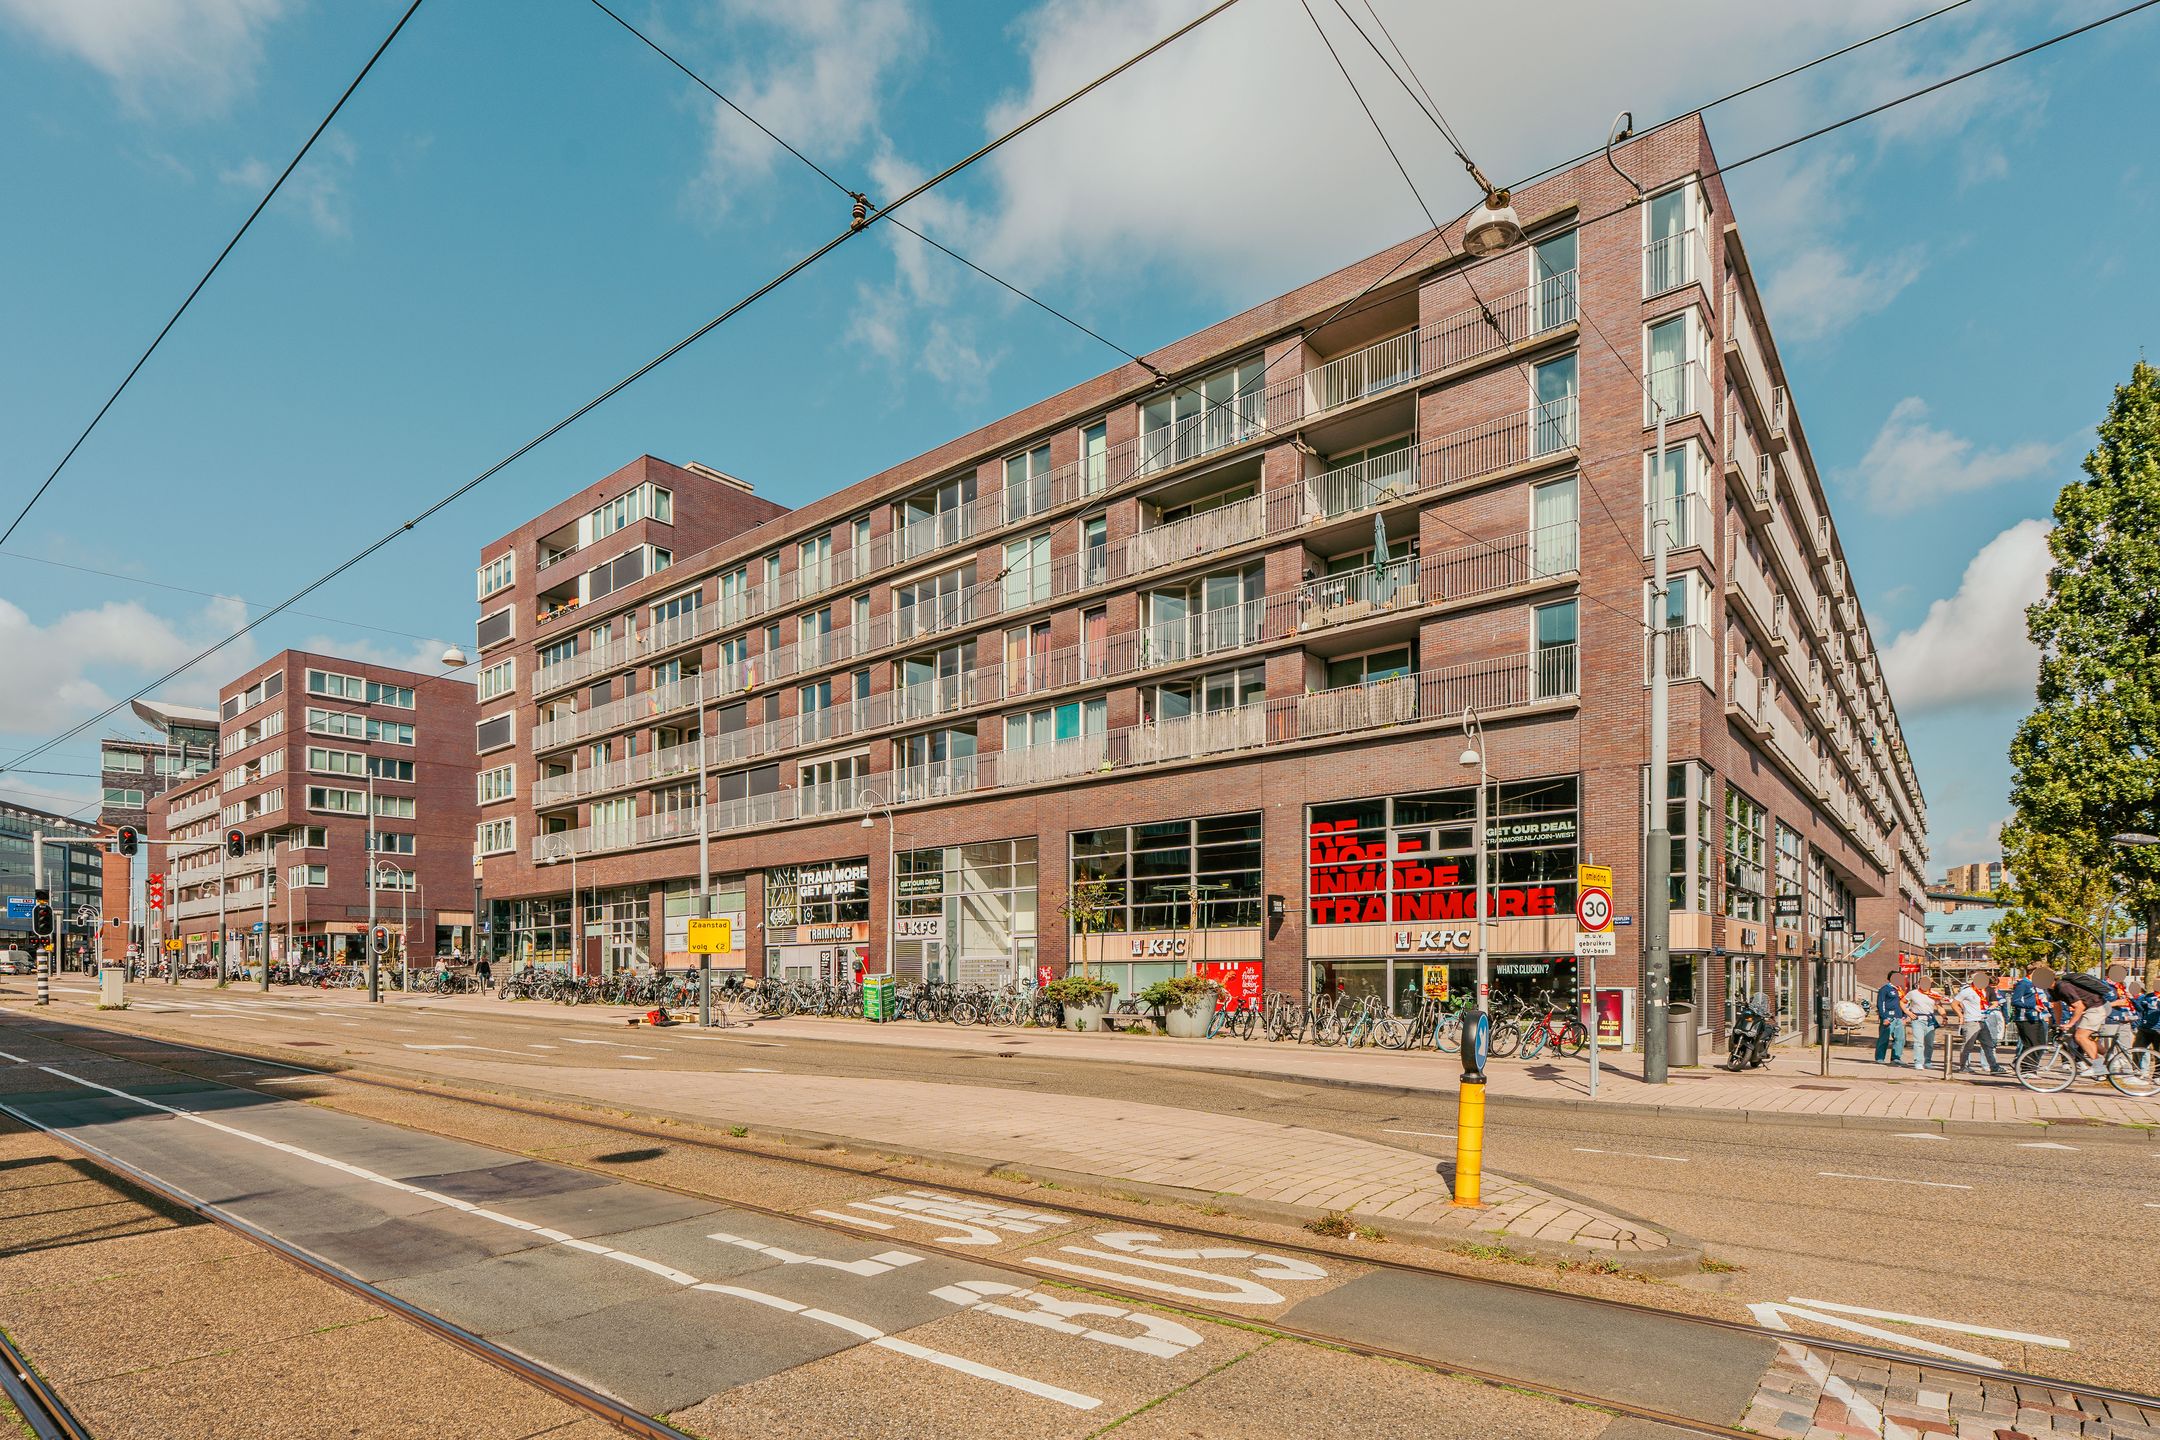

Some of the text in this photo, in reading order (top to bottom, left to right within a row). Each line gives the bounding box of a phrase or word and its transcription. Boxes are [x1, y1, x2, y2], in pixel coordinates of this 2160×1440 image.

[1310, 819, 1358, 849] RE
[1486, 821, 1576, 837] GET OUR DEAL
[1310, 840, 1422, 874] MORE
[800, 866, 868, 885] TRAIN MORE
[800, 881, 856, 897] GET MORE
[900, 880, 912, 888] GET
[1310, 886, 1556, 925] TRAINMORE
[1584, 901, 1607, 918] 30
[808, 927, 851, 940] TRAINMORE
[912, 920, 937, 935] KFC
[692, 943, 708, 951] volg
[1148, 938, 1186, 954] KFC
[1418, 930, 1471, 950] KFC
[1578, 940, 1612, 948] gebruikers
[821, 952, 830, 961] 92
[1496, 964, 1550, 975] WHAT'S CLUCKIN'?
[928, 1230, 1329, 1360] BUS
